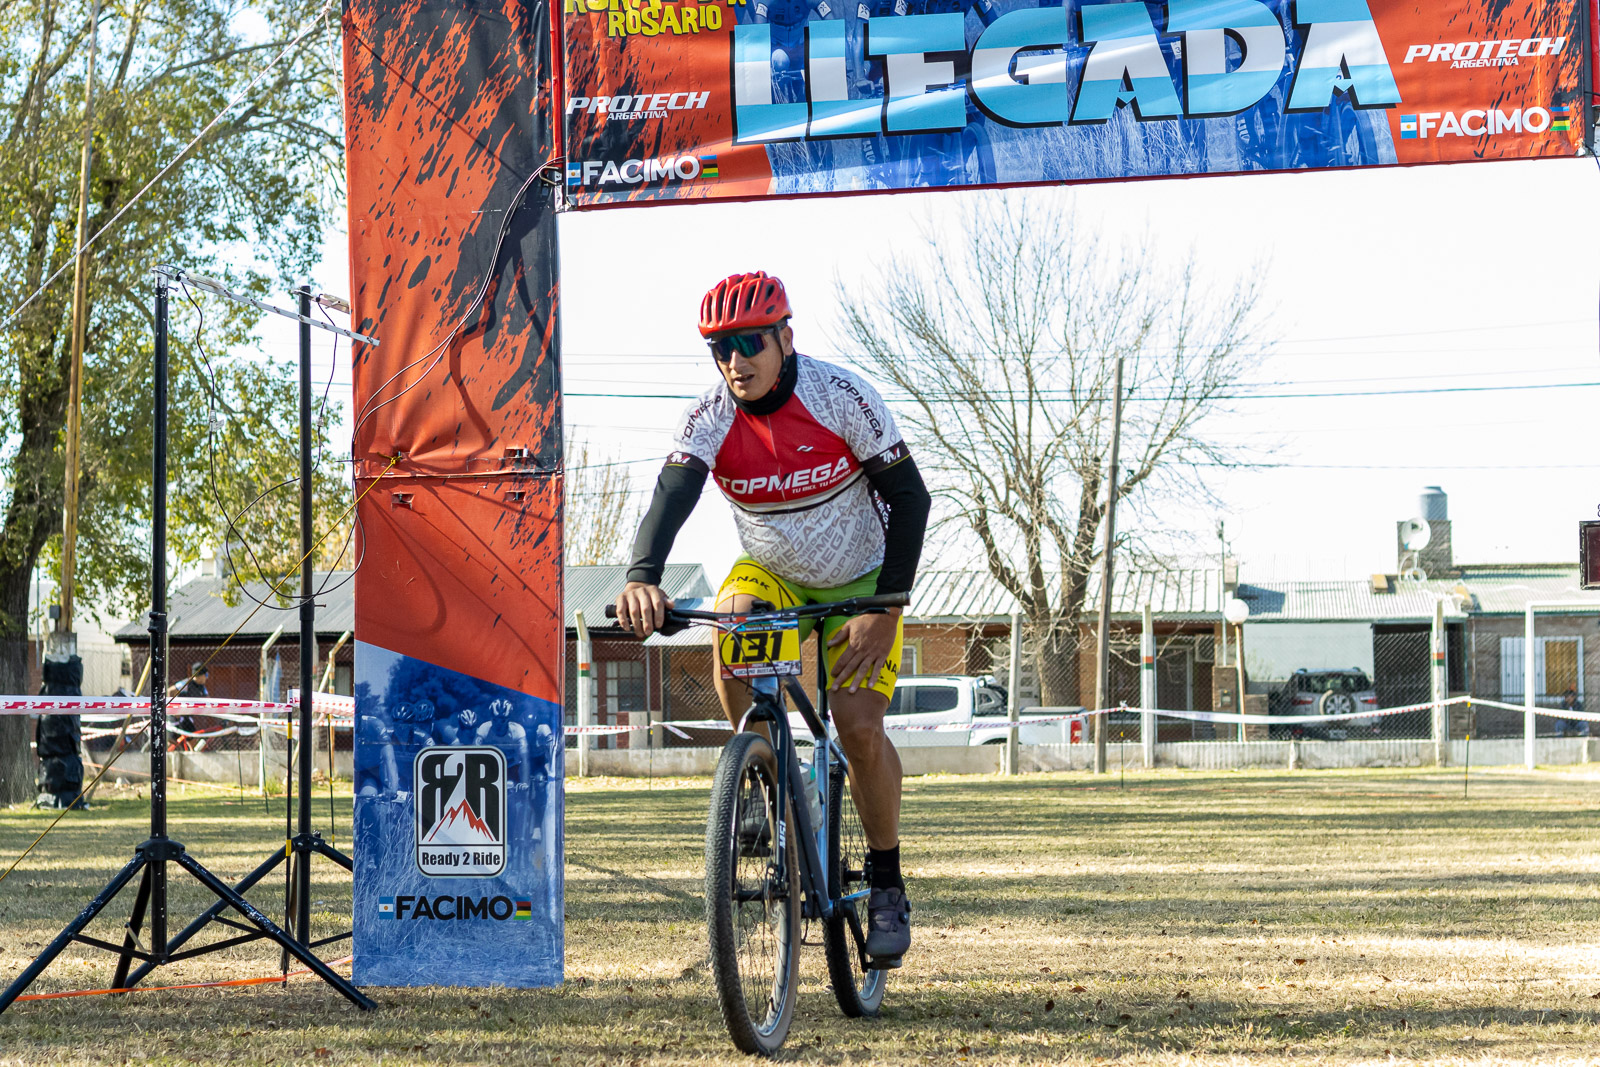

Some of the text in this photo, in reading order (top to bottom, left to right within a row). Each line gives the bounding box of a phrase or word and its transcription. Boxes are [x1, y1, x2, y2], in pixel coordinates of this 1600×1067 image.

[608, 4, 722, 37] ROSARIO
[1403, 36, 1566, 64] PROTECH
[1450, 57, 1519, 69] ARGENTINA
[731, 0, 1402, 144] LLEGADA
[565, 91, 710, 115] PROTECH
[606, 110, 668, 121] ARGENTINA
[1419, 106, 1551, 139] FACIMO
[583, 155, 700, 186] FACIMO
[829, 375, 884, 440] TOPMEGA
[718, 456, 850, 495] TOPMEGA
[822, 508, 866, 585] TOPMEGA
[730, 630, 784, 664] 131
[421, 851, 501, 867] Ready 2 Ride
[396, 894, 514, 921] FACIMO
